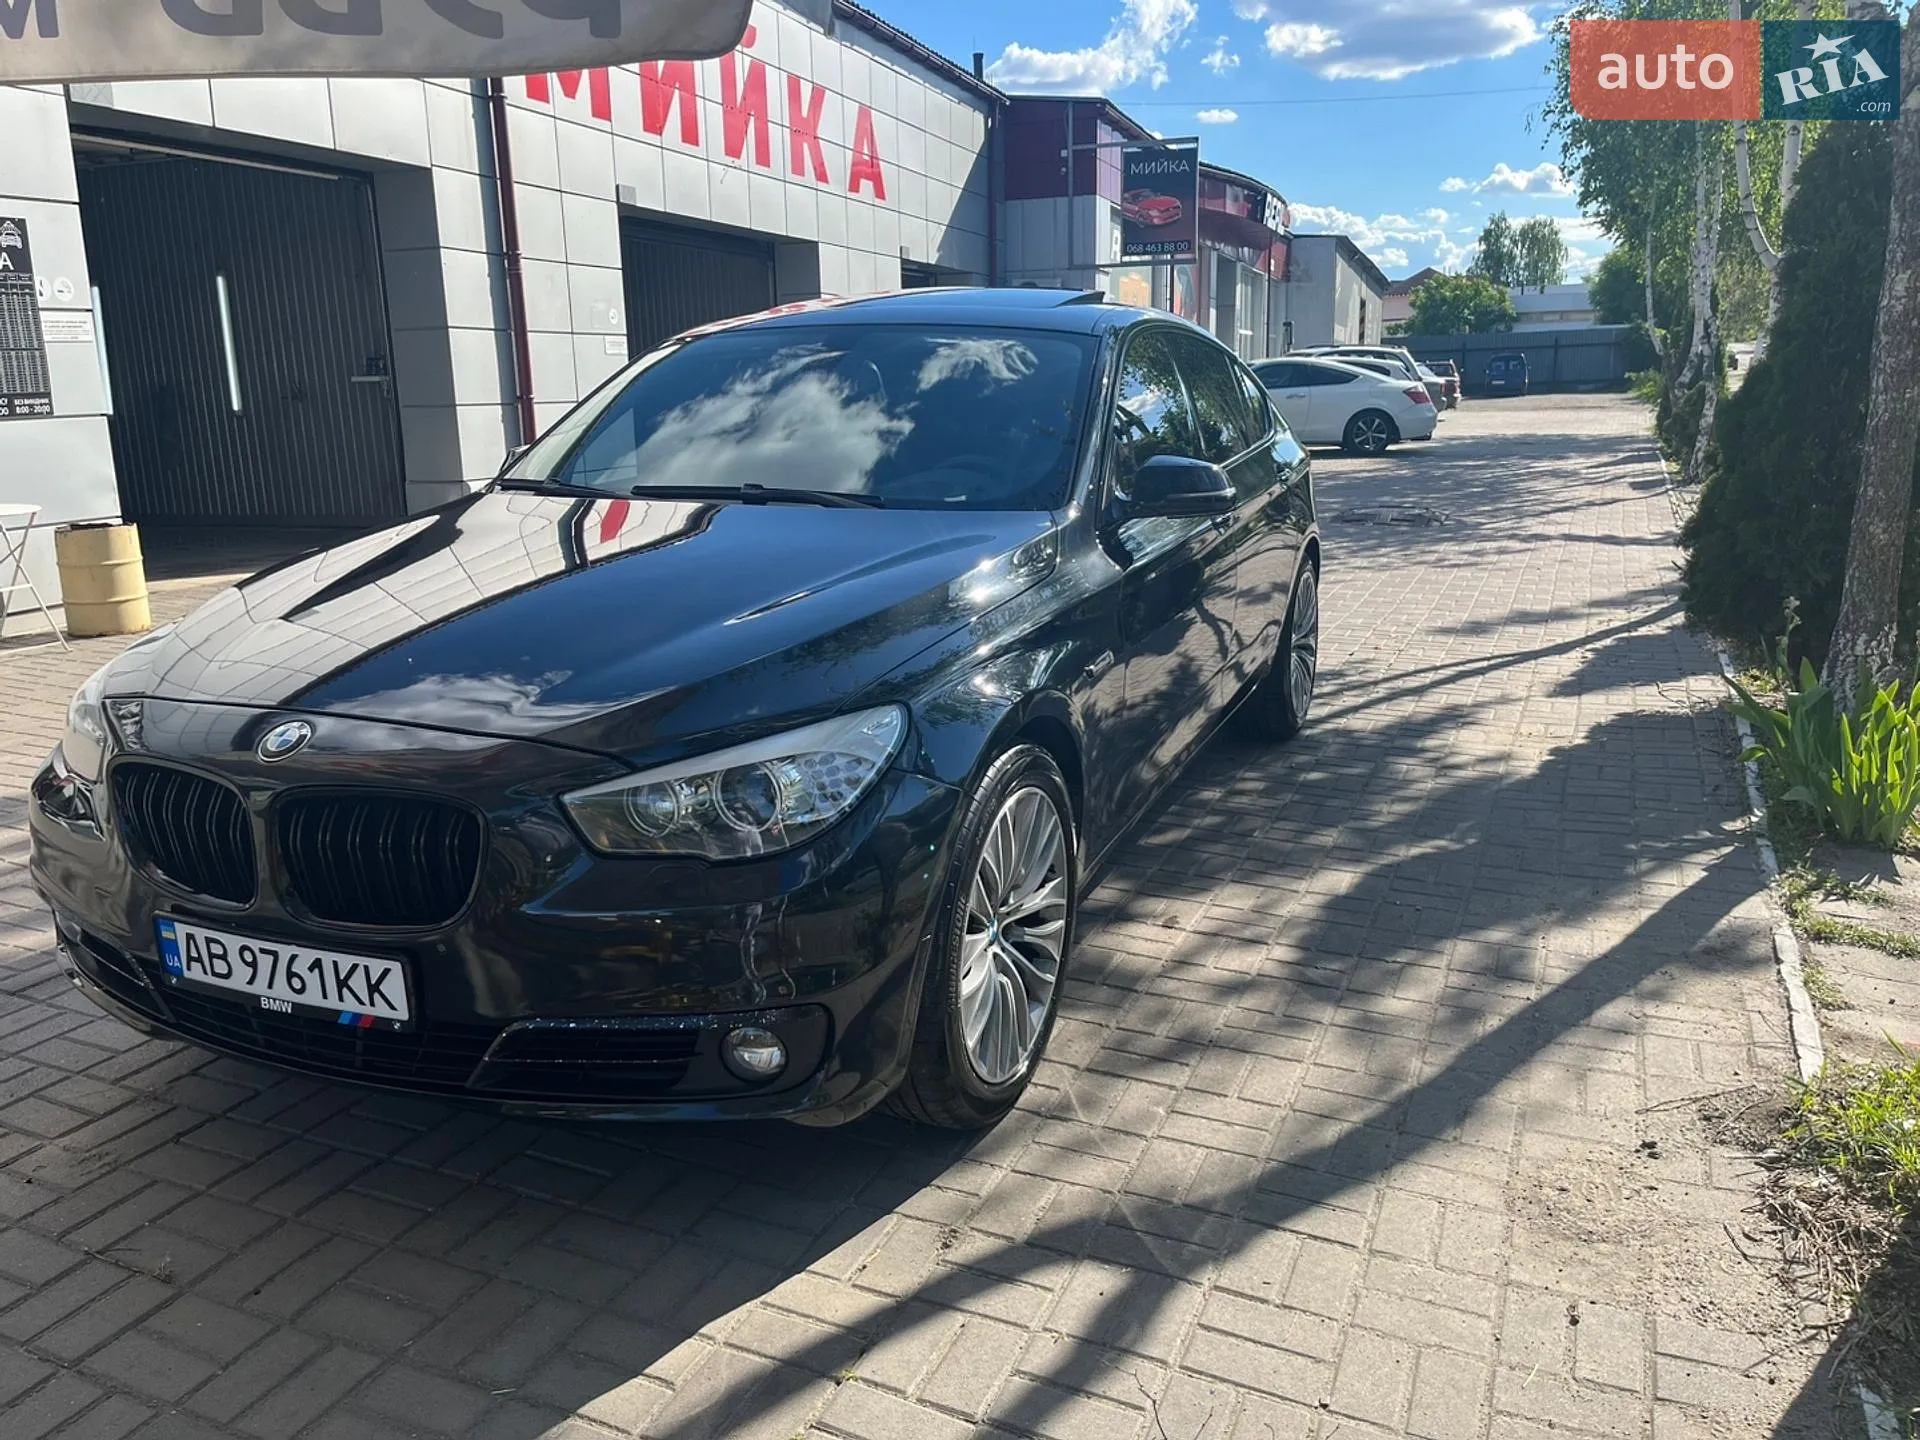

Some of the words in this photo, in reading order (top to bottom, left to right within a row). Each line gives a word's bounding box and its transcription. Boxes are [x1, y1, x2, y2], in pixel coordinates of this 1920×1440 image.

[1130, 158, 1190, 175] МИЙКА
[1126, 243, 1144, 254] 068
[1145, 243, 1162, 253] 463
[1177, 241, 1189, 251] 00
[165, 954, 181, 968] UA
[260, 997, 292, 1014] BMW
